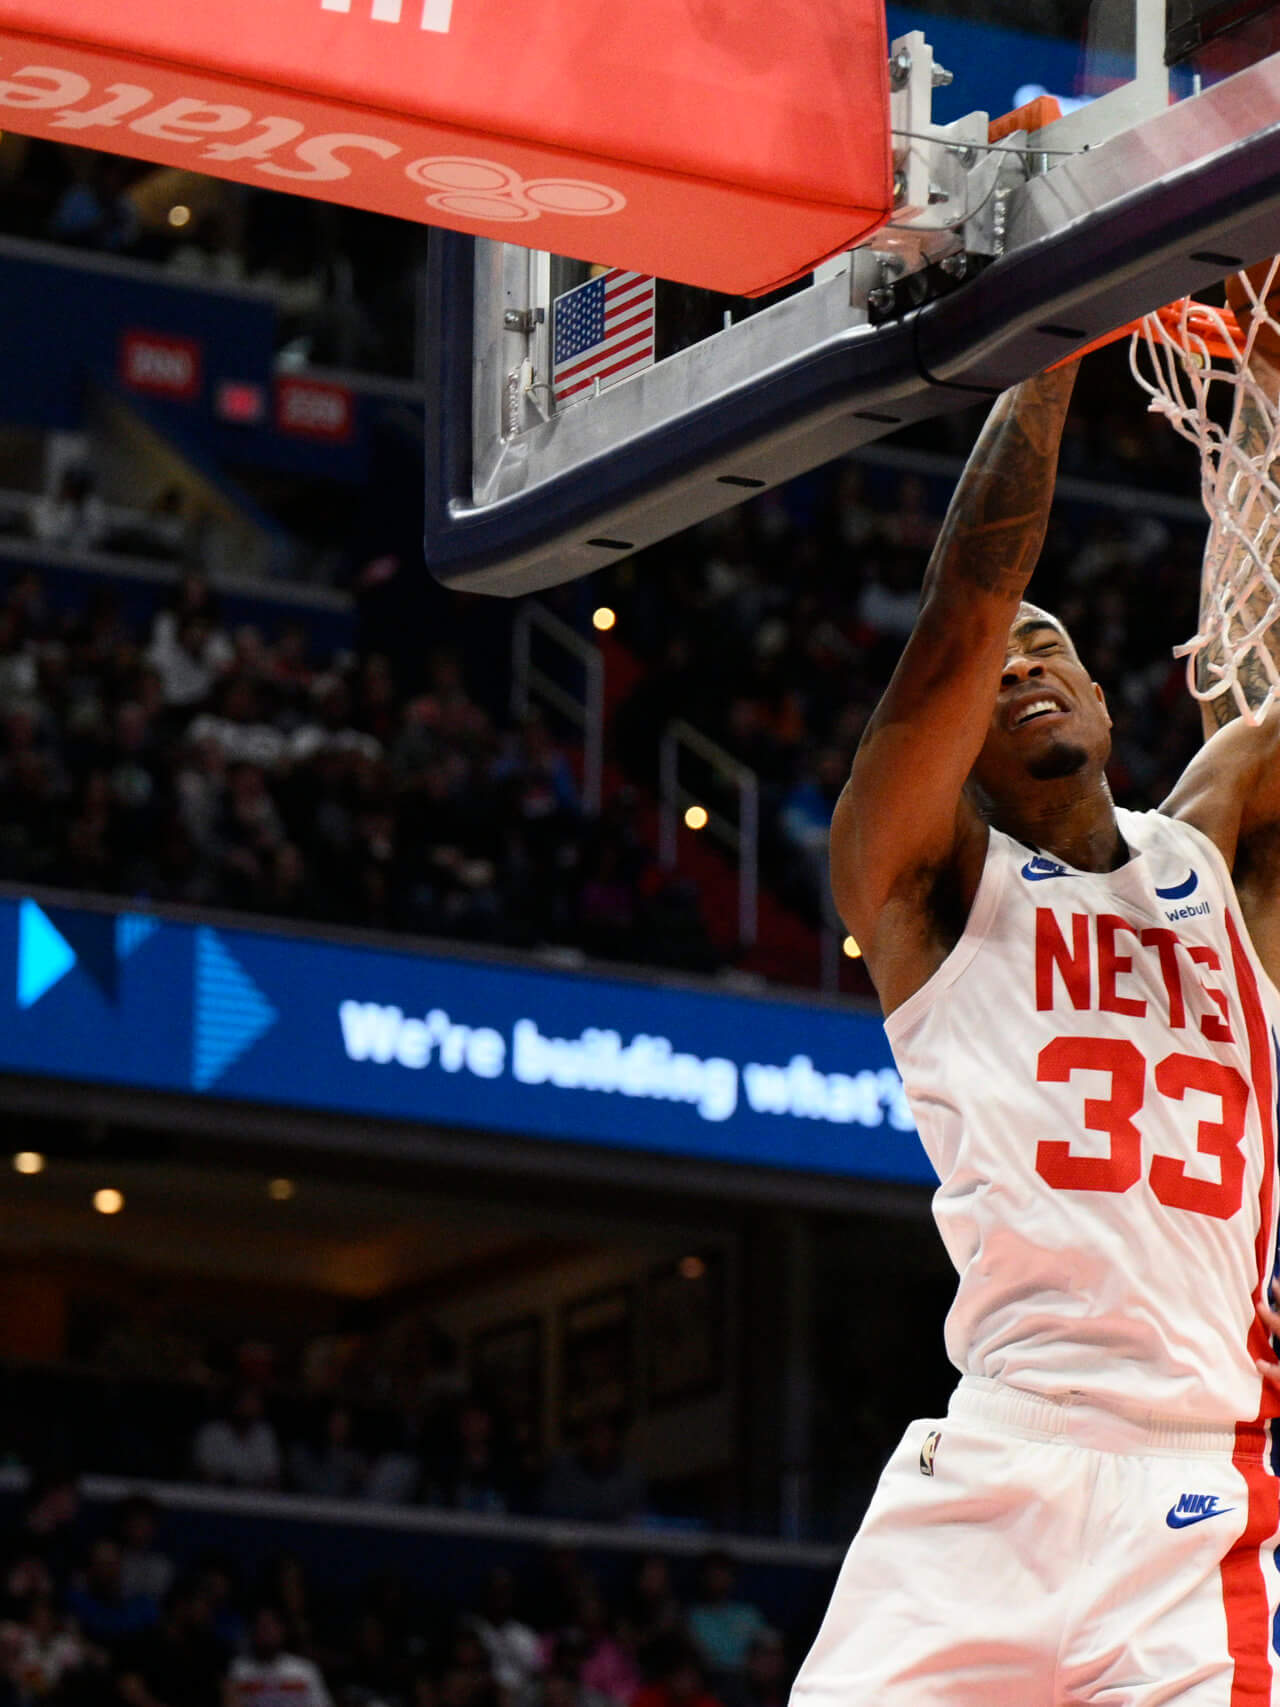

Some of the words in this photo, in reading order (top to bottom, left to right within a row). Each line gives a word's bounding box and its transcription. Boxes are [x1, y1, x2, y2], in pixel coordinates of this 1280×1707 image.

[0, 65, 401, 182] State
[1165, 901, 1210, 921] Webull
[1035, 907, 1236, 1044] NETS
[339, 1000, 506, 1079] We're
[512, 1018, 738, 1122] building
[1035, 1036, 1250, 1221] 33
[1176, 1493, 1220, 1514] NIKE
